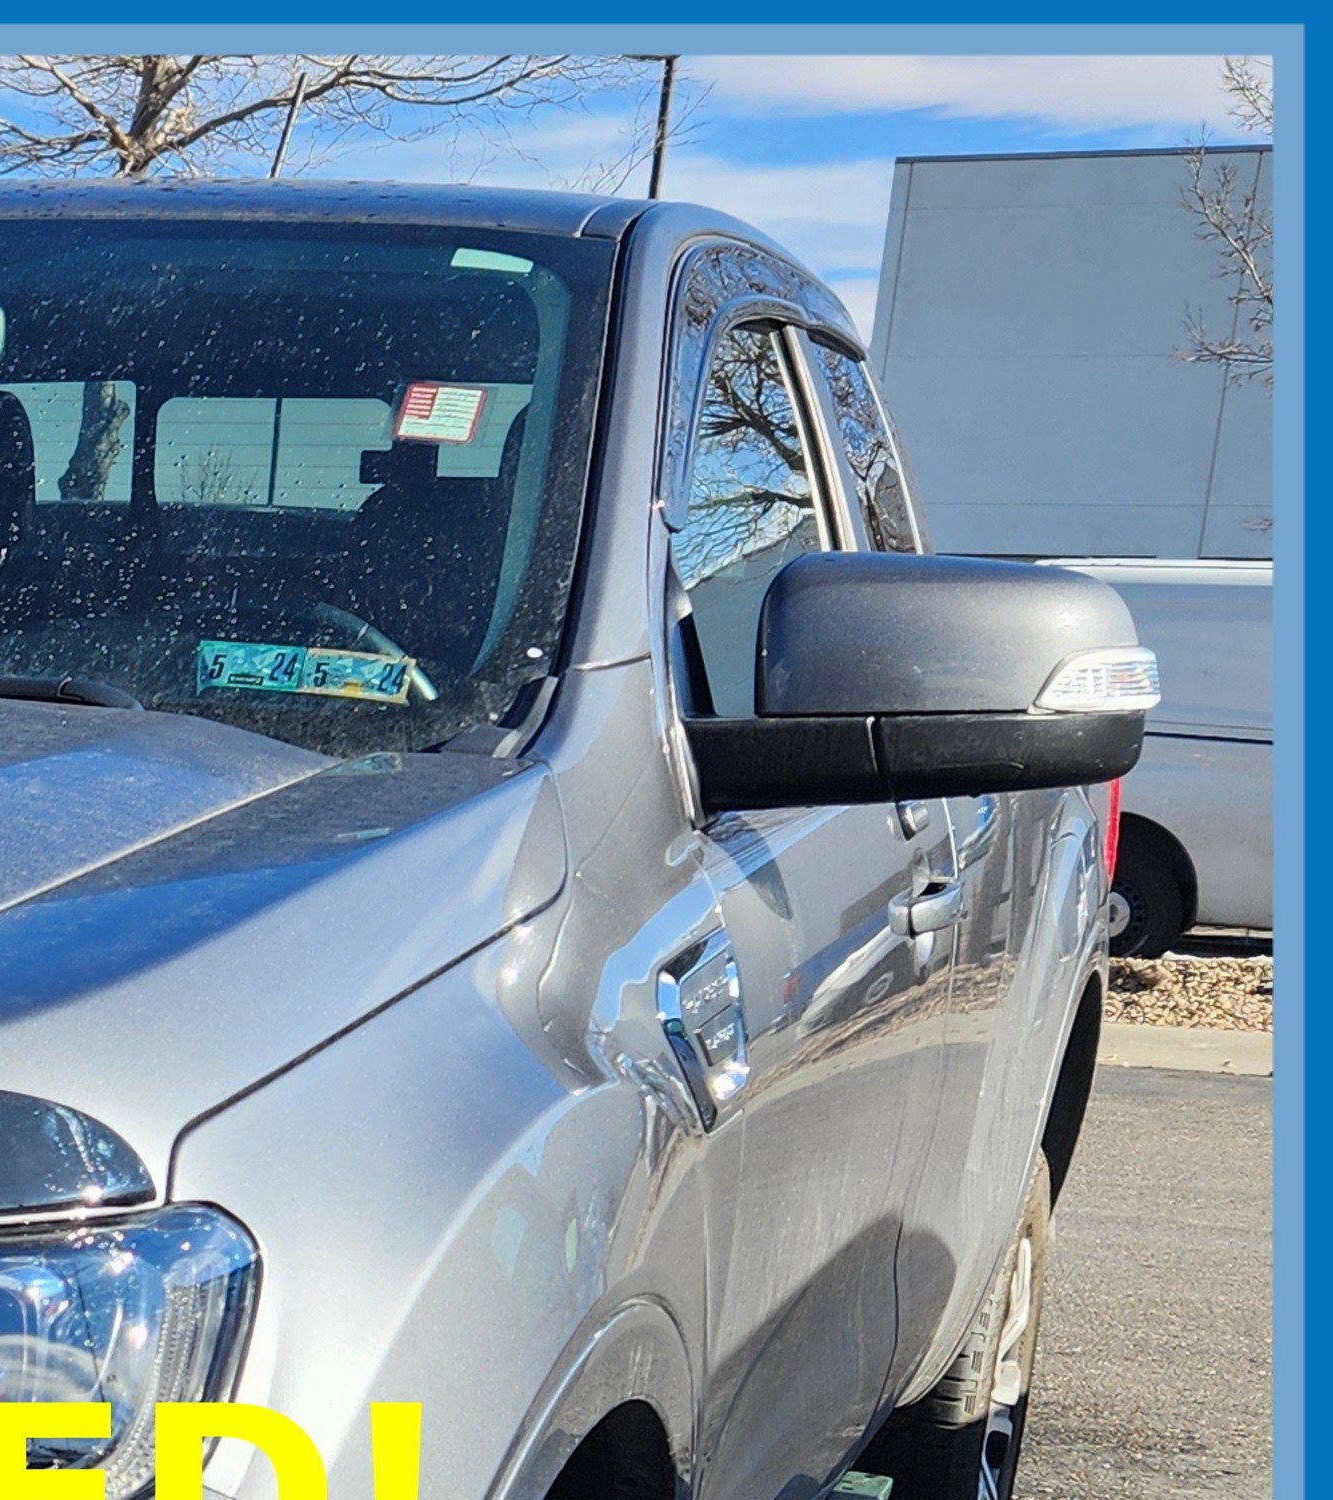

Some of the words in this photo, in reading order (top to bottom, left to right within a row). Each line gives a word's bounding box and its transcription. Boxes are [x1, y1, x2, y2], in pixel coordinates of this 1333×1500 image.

[208, 654, 226, 680] 5
[269, 652, 299, 683] 24
[313, 662, 330, 687] 5
[377, 663, 407, 694] 24
